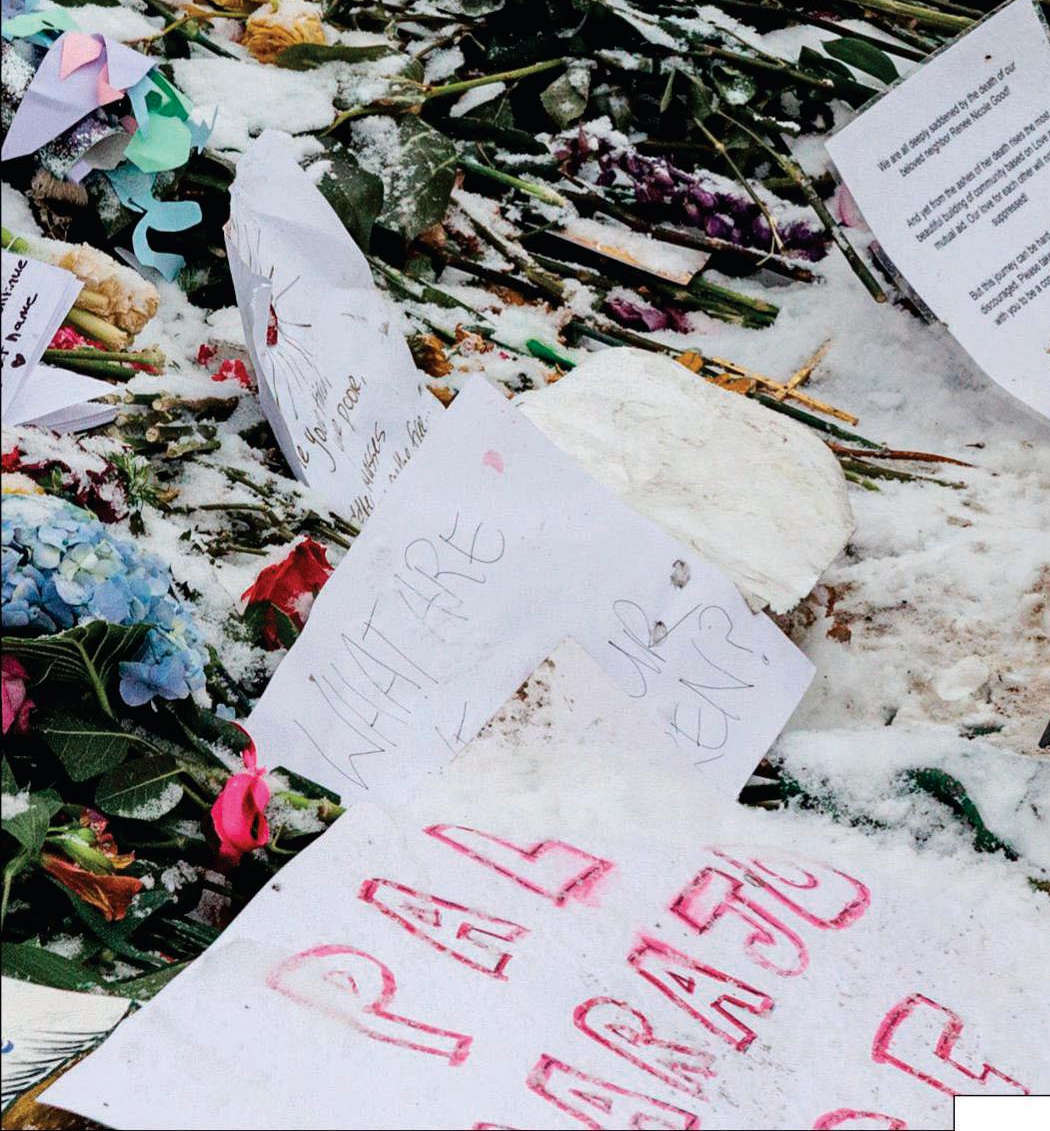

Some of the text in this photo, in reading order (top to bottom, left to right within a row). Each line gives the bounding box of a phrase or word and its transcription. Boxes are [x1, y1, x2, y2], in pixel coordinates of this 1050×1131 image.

[899, 153, 925, 177] beloved
[923, 133, 951, 157] neighbor
[949, 117, 972, 137] Renee
[969, 102, 992, 121] Nicole
[908, 129, 930, 149] deeply
[928, 104, 960, 133] saddened
[978, 76, 998, 94] death
[915, 217, 944, 242] beautiful
[941, 198, 969, 222] building
[973, 168, 1007, 197] community
[1003, 151, 1026, 172] based
[1031, 134, 1049, 150] Love
[928, 194, 946, 209] from
[955, 171, 976, 190] ashes
[991, 143, 1010, 161] death
[1008, 131, 1026, 147] rises
[1033, 110, 1050, 127] most
[978, 199, 994, 213] love
[1001, 180, 1018, 196] each
[1017, 167, 1033, 184] other
[1032, 157, 1045, 171] will
[980, 278, 996, 291] this
[994, 260, 1018, 284] journey
[1016, 263, 1041, 283] Please
[994, 311, 1009, 326] with
[292, 511, 506, 791] WHAT ARE
[664, 605, 770, 765] EN?
[265, 823, 616, 1068] PAL
[472, 847, 872, 1130] ARAJO
